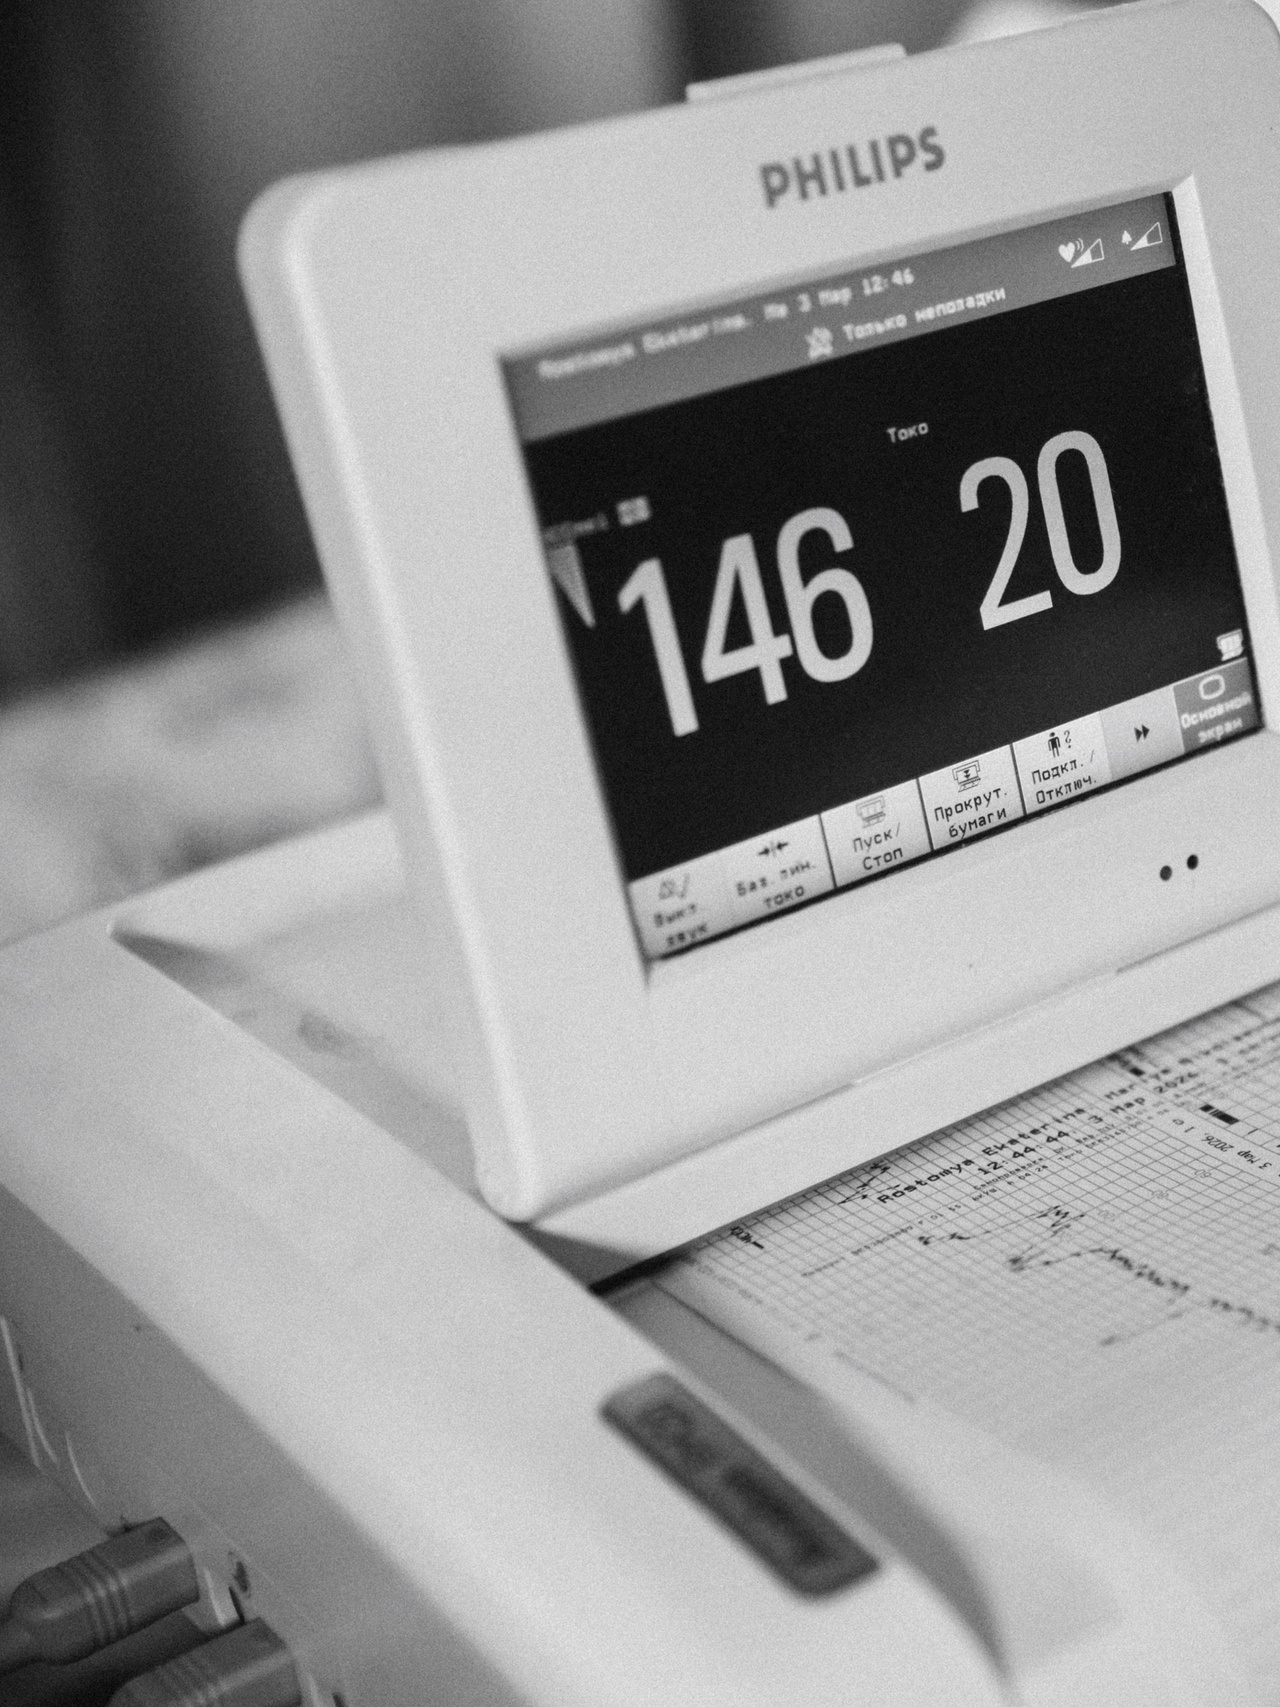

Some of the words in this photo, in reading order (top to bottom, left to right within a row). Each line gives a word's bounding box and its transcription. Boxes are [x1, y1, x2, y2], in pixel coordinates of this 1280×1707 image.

[760, 126, 945, 209] PHILIPS
[861, 267, 915, 296] 12:46
[842, 314, 908, 342] Только
[915, 288, 1006, 323] неполадки
[886, 422, 929, 444] Токо
[958, 429, 1123, 632] 20
[616, 505, 874, 738] 146
[1179, 691, 1253, 730] Основной
[933, 787, 1009, 823] Прокрут.
[1035, 775, 1099, 805] Отключ.
[852, 820, 901, 853] Пуск/
[948, 806, 1009, 839] бумаги
[861, 846, 905, 871] Стоп
[762, 885, 806, 909] токо
[877, 1156, 976, 1205] Rostomya
